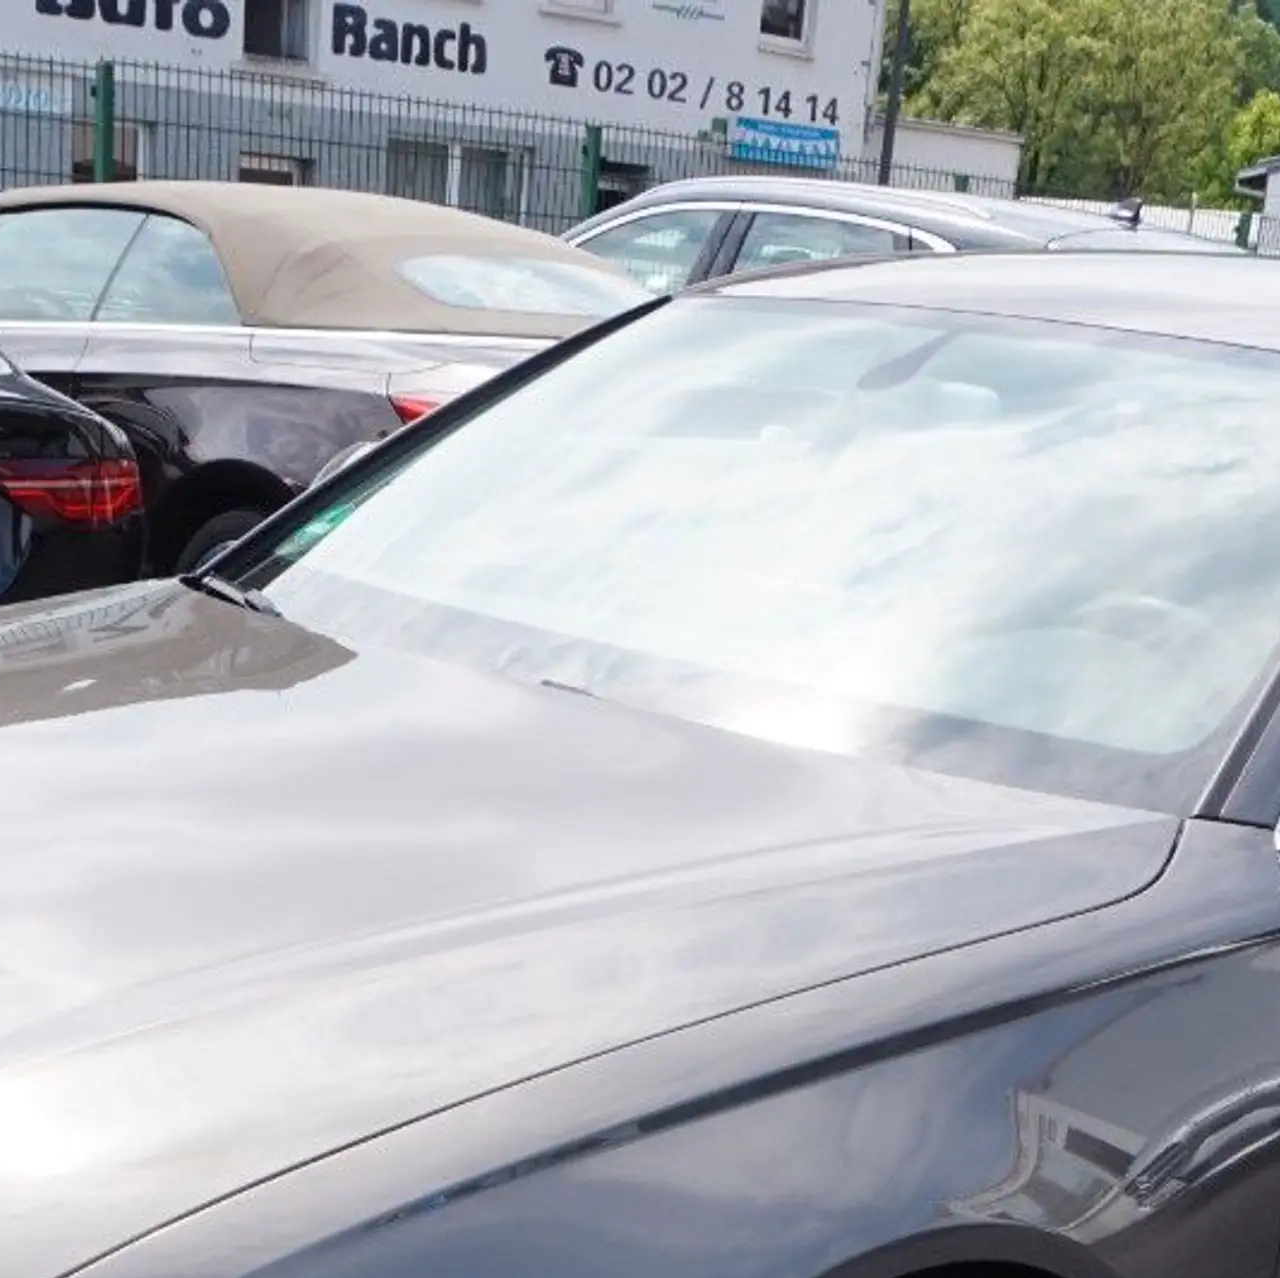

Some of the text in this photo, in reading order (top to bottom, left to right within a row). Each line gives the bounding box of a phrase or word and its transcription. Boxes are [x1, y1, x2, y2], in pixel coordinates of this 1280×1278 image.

[332, 3, 487, 74] Ranch
[593, 60, 635, 95] 02
[647, 68, 688, 103] 02
[725, 81, 745, 111] 8
[757, 86, 792, 118] 14
[805, 93, 839, 125] 14
